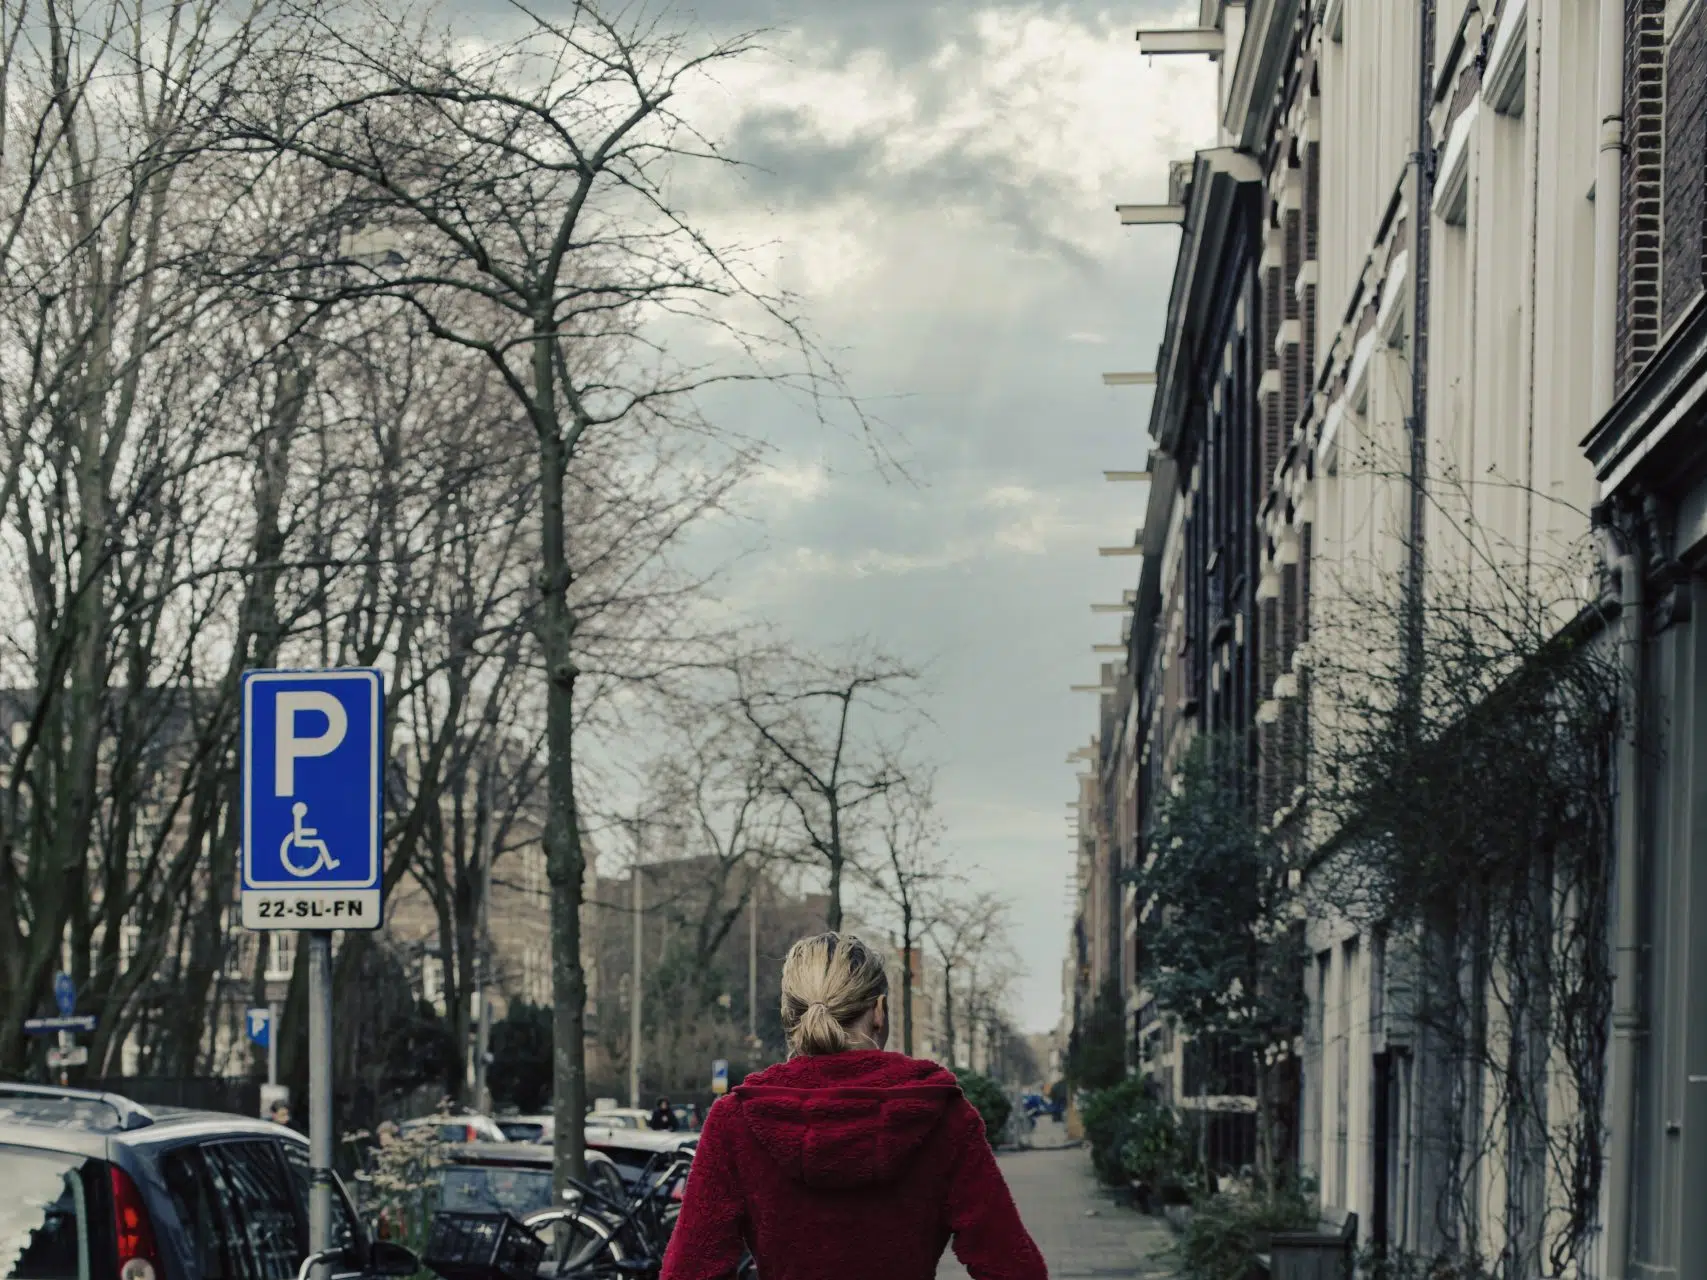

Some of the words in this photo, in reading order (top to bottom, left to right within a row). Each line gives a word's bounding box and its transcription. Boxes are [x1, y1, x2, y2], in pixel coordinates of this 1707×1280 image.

[275, 690, 348, 797] P
[259, 900, 363, 918] 22-SL-FN
[252, 1015, 265, 1037] P
